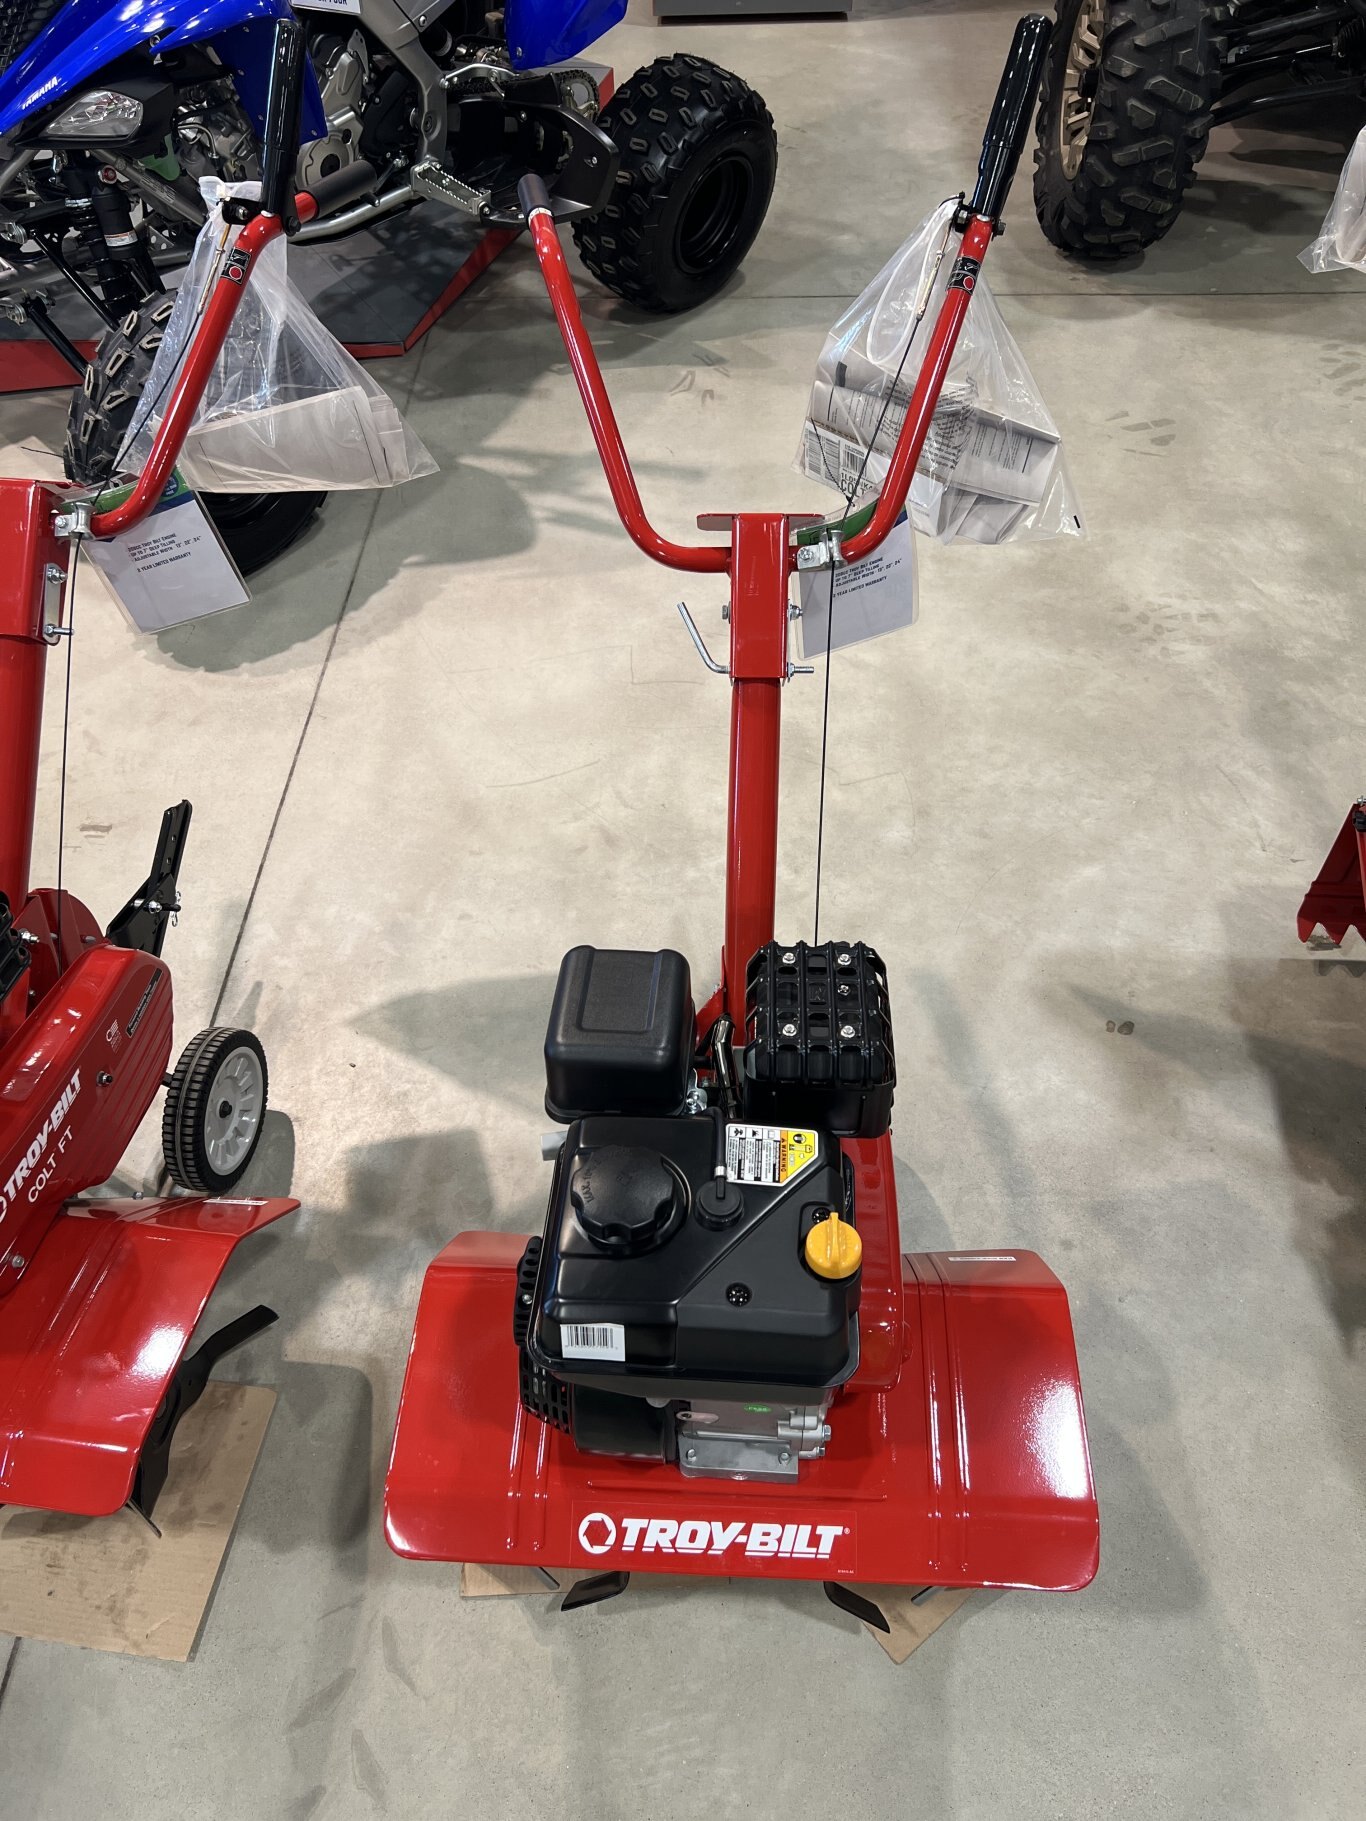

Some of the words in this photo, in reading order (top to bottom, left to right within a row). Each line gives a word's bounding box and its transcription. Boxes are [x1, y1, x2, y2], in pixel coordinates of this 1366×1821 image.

[141, 564, 152, 572] YEAR
[153, 559, 169, 568] LIMITED
[169, 552, 191, 562] WARRANTY
[870, 557, 883, 566] ENGINE
[849, 583, 864, 592] LIMITED
[865, 576, 887, 587] WARRANTY
[4, 1068, 81, 1202] TROY-BILT
[28, 1153, 56, 1203] COLT
[58, 1125, 73, 1154] FT
